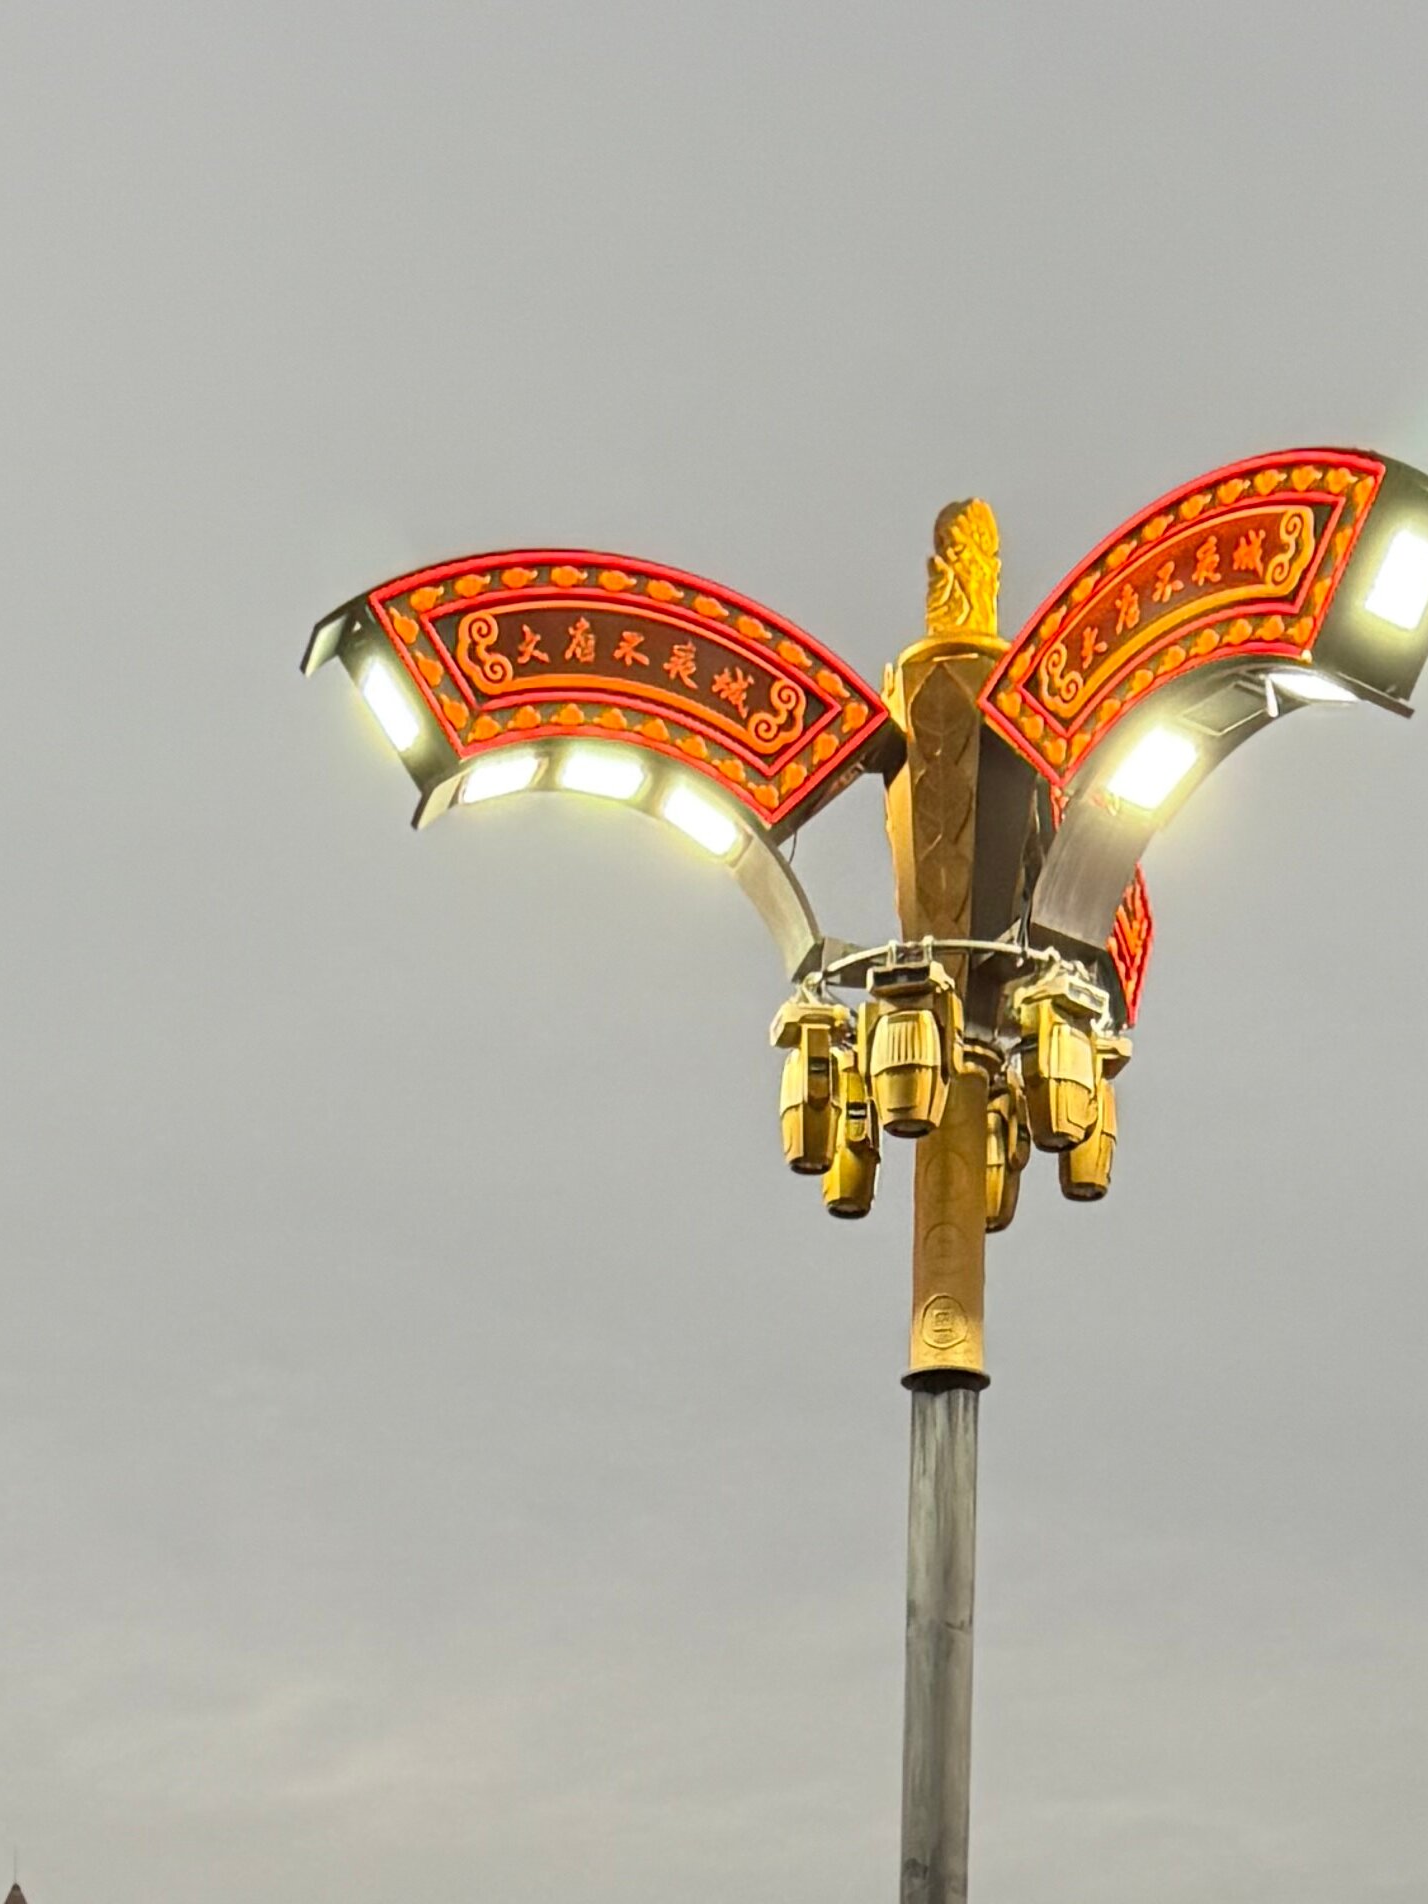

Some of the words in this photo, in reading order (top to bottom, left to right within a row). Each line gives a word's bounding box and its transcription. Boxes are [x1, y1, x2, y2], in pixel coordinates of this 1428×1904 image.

[1081, 528, 1266, 670] 大唐不夜城
[516, 616, 755, 720] 大唐不夜城
